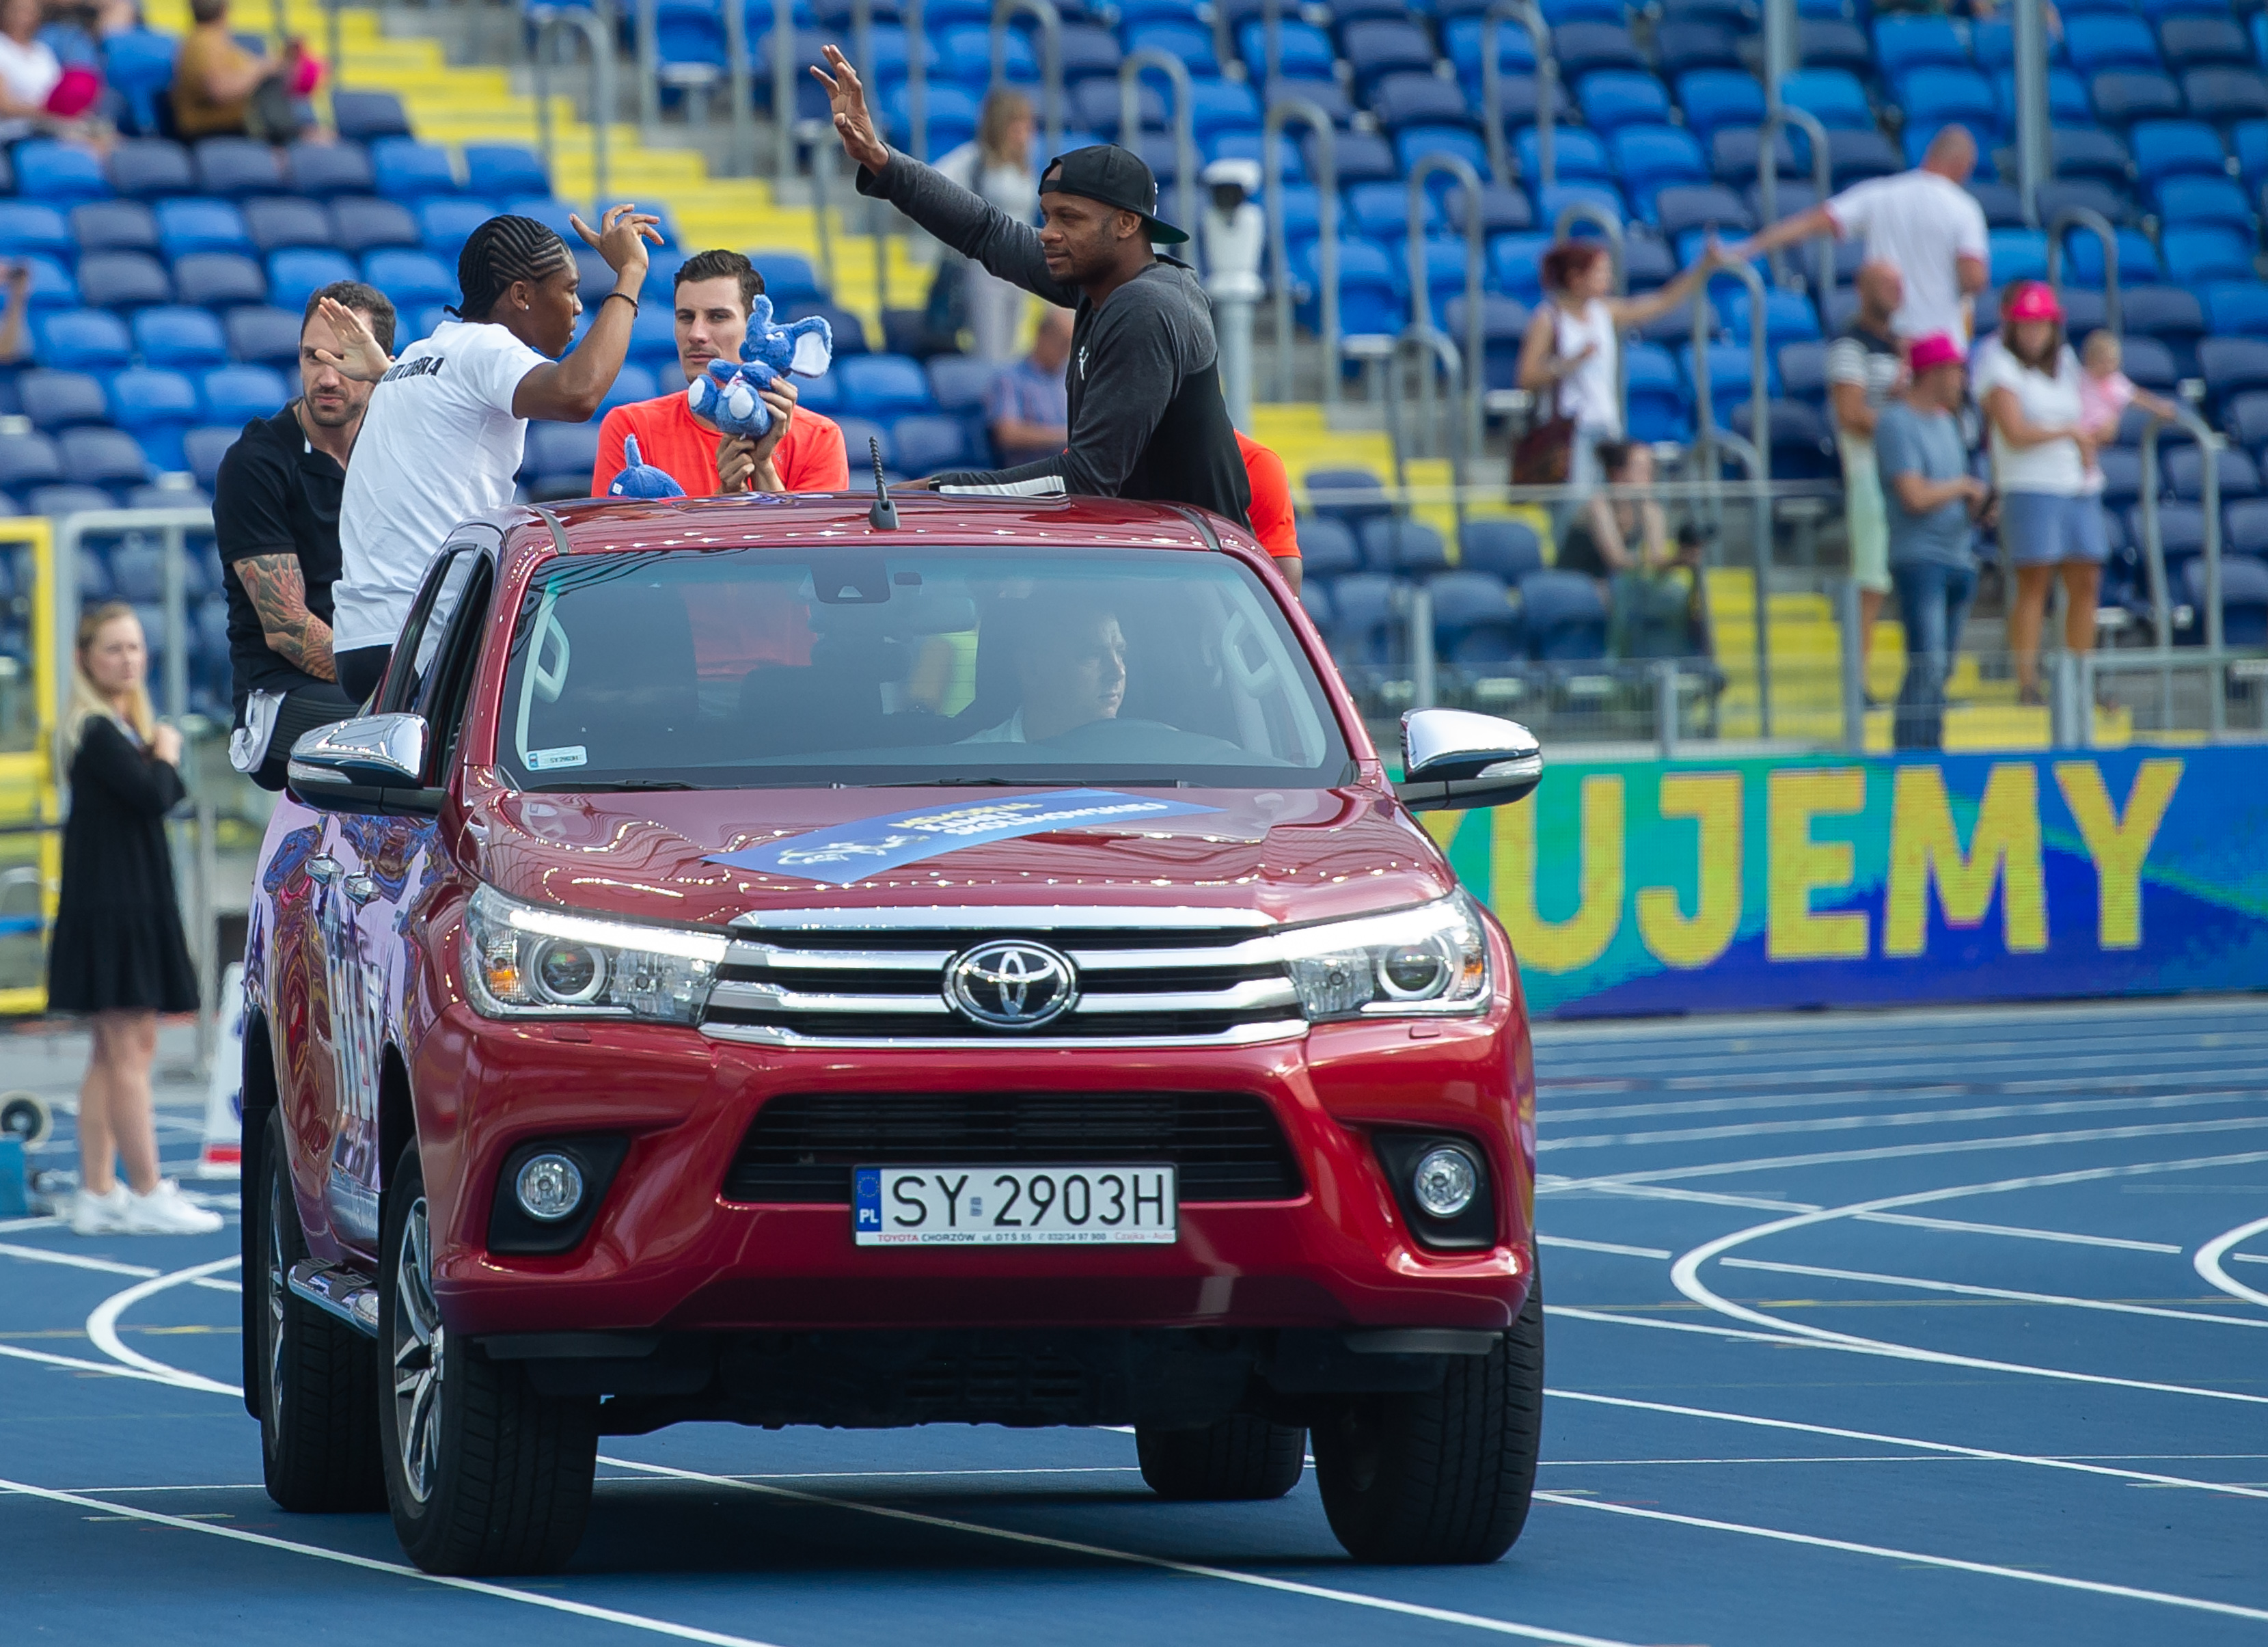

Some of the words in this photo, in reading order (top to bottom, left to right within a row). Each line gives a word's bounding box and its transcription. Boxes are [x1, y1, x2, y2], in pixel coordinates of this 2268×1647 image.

[1421, 757, 2185, 973] UJEMY
[859, 1208, 879, 1224] PL
[892, 1174, 969, 1227] SY
[993, 1173, 1164, 1227] 2903H
[877, 1234, 918, 1242] TOYOTA
